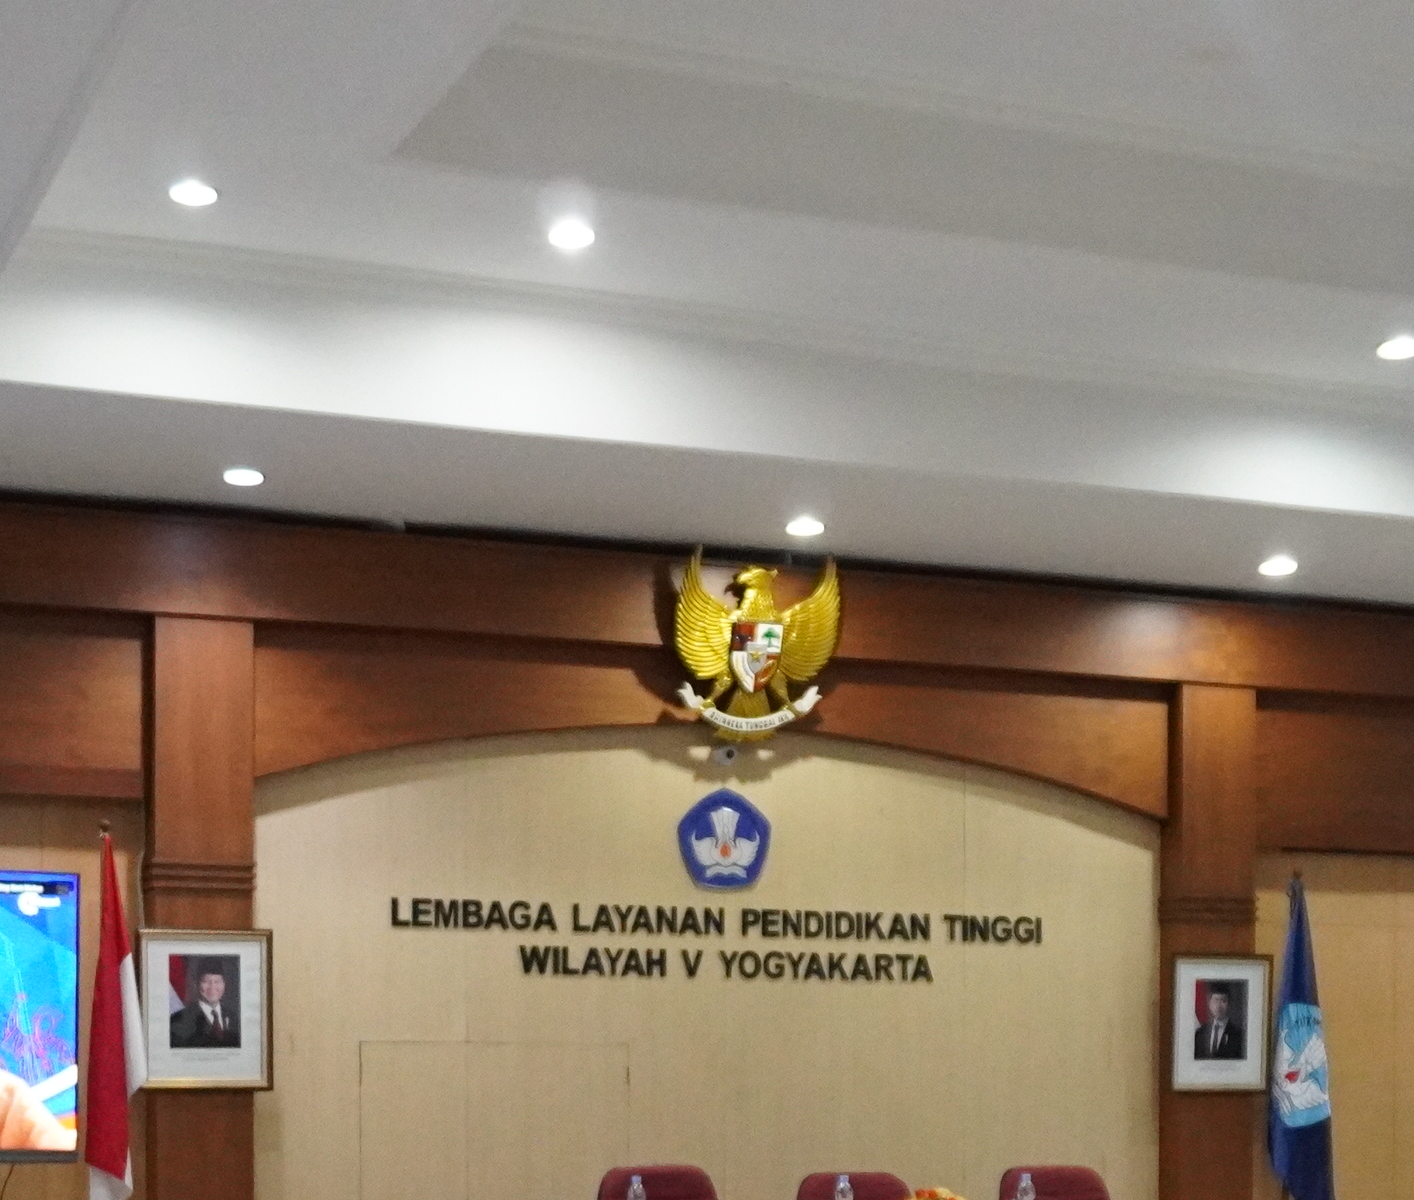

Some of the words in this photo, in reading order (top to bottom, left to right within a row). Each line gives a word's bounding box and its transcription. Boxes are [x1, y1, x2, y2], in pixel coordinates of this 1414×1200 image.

[390, 896, 558, 932] LEMBAGA
[571, 903, 725, 937] LAYANAN
[741, 908, 931, 942] PENDIDIKAN
[942, 913, 1043, 946] TINGGI
[518, 944, 667, 979] WILAYAH
[681, 949, 703, 980] V
[719, 950, 934, 983] YOGYAKARTA
